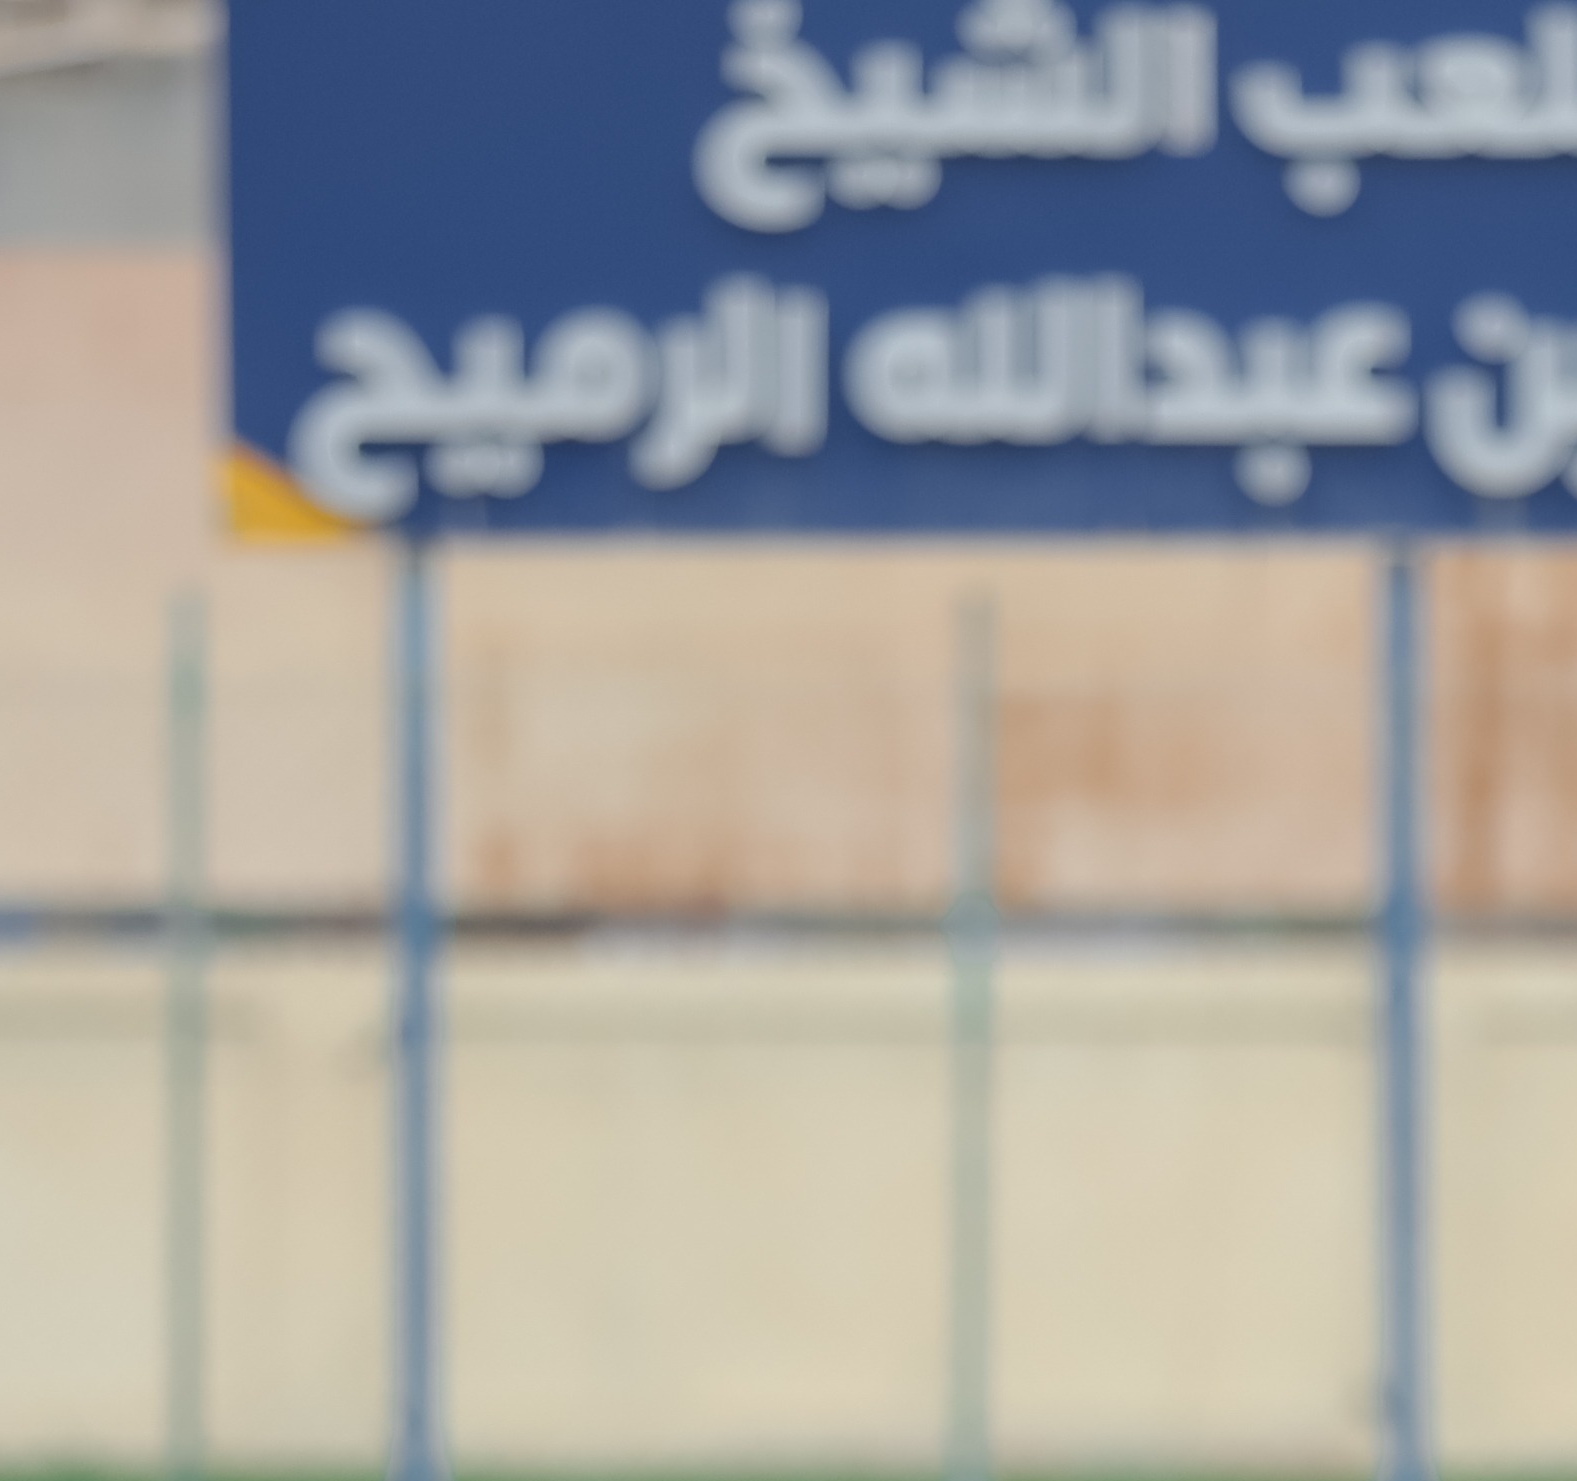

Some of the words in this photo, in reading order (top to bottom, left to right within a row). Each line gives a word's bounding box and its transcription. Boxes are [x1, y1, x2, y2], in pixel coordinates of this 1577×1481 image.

[690, 0, 1220, 235] الشيخ
[286, 271, 830, 525] الرميح
[842, 272, 1416, 508] عبدالله
